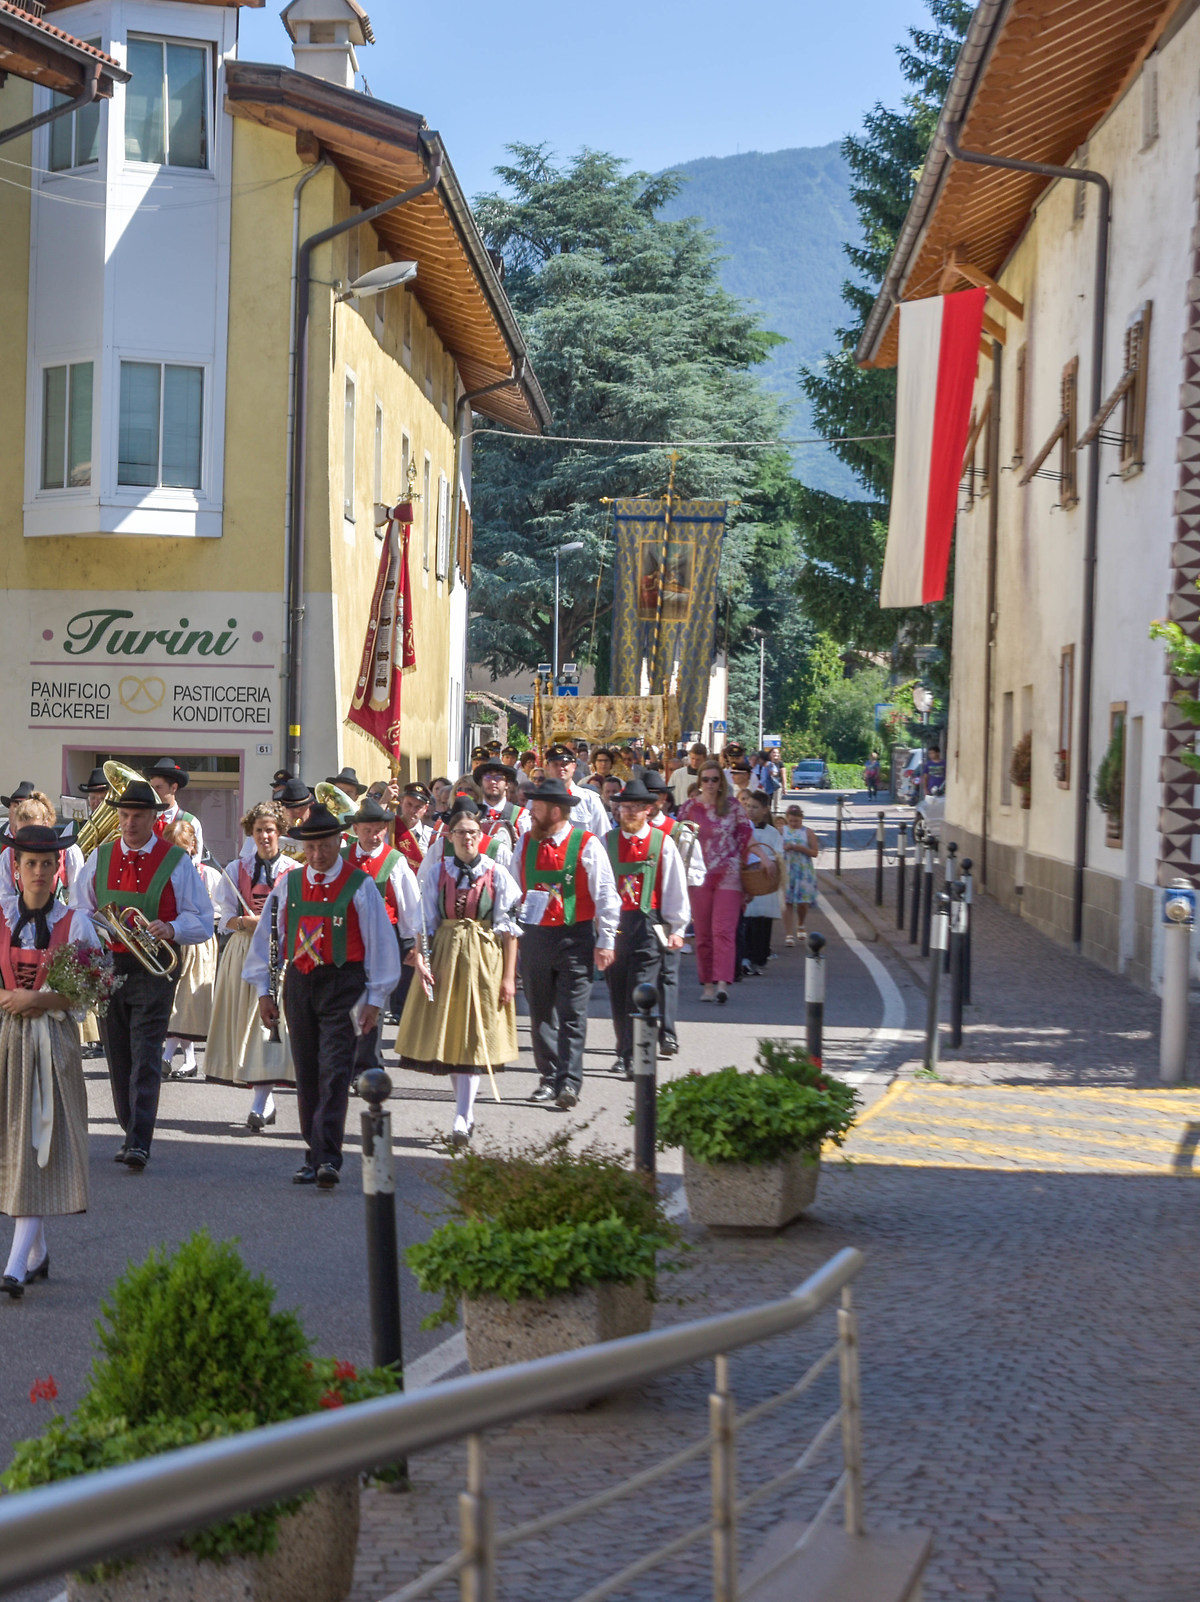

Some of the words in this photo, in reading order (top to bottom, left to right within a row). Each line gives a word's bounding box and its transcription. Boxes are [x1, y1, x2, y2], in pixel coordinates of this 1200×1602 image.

[63, 609, 239, 656] Turini
[31, 681, 111, 699] PANIFICIO
[173, 685, 271, 702] PASTICCERIA
[30, 698, 110, 720] BÄCKEREI
[173, 705, 270, 723] KONDITOREI
[259, 745, 268, 753] 61
